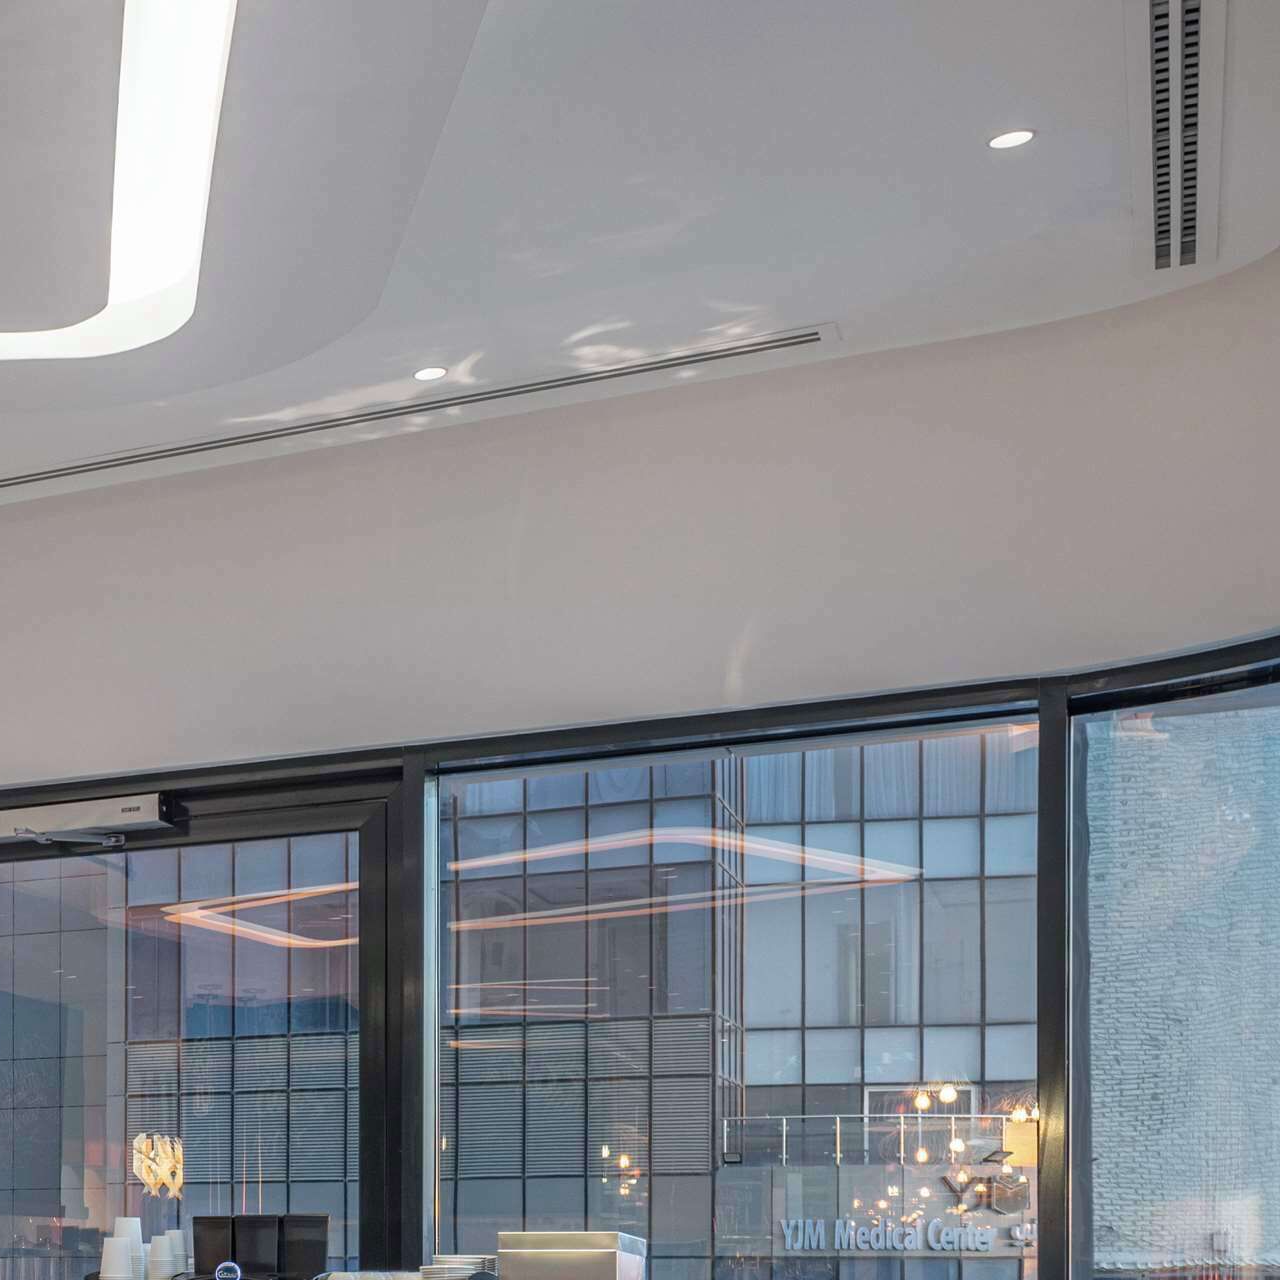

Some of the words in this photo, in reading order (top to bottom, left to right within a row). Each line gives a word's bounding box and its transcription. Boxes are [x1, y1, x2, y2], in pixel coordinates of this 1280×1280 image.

[780, 1218, 825, 1251] YJM
[834, 1218, 922, 1251] Medical
[927, 1217, 996, 1251] Center
